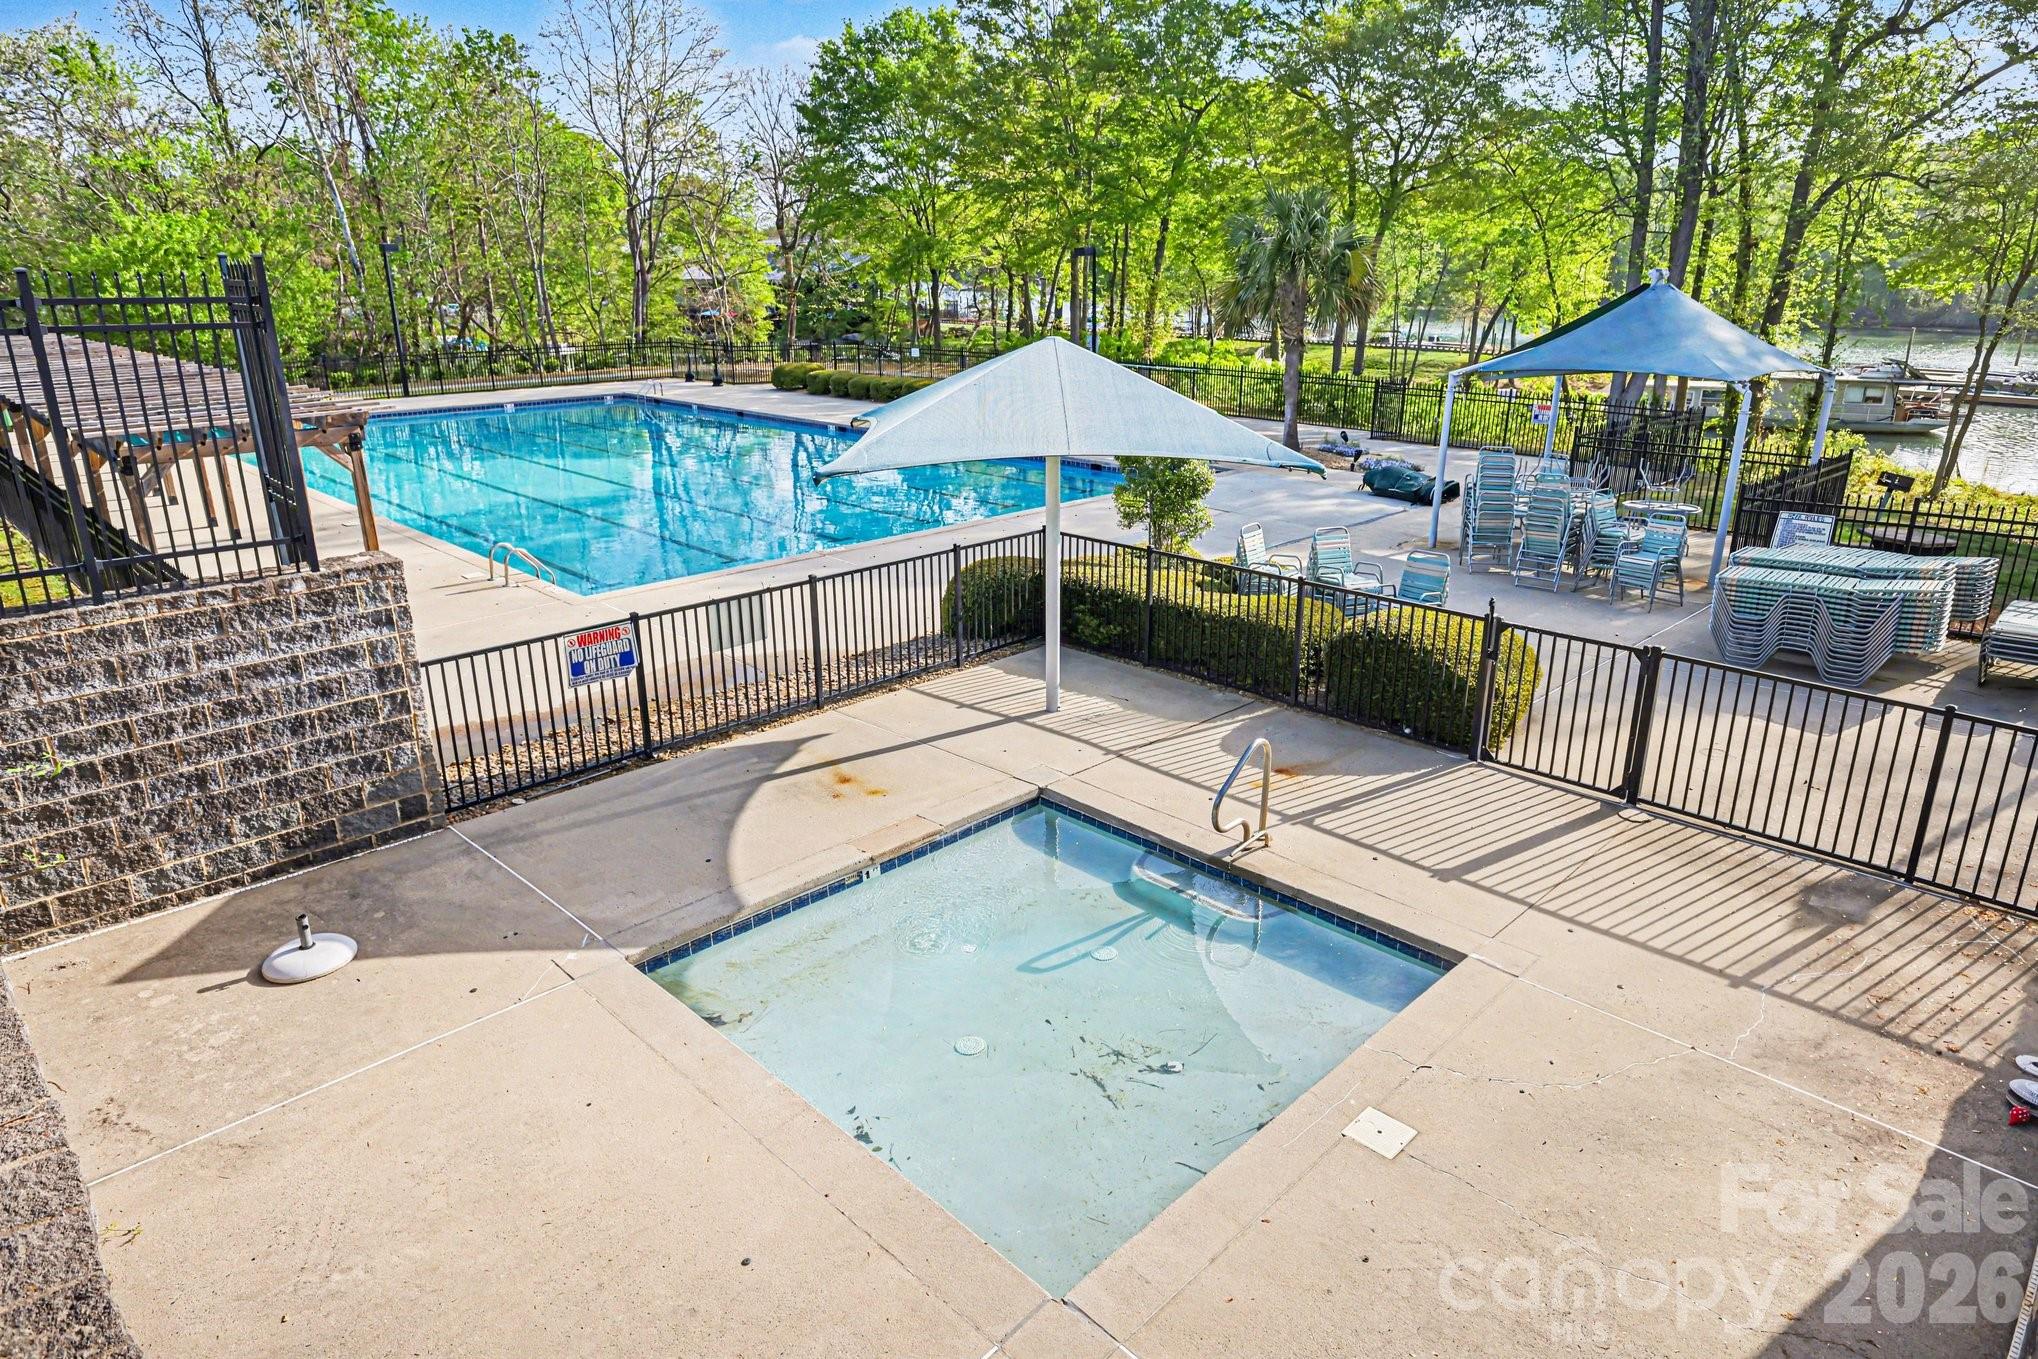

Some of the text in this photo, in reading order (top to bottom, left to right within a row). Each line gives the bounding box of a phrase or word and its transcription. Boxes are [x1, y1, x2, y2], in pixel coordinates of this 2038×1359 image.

[577, 626, 621, 647] WARNING
[572, 639, 630, 663] NO LIFEGUARD
[584, 659, 597, 674] ON
[598, 654, 620, 671] DUTY
